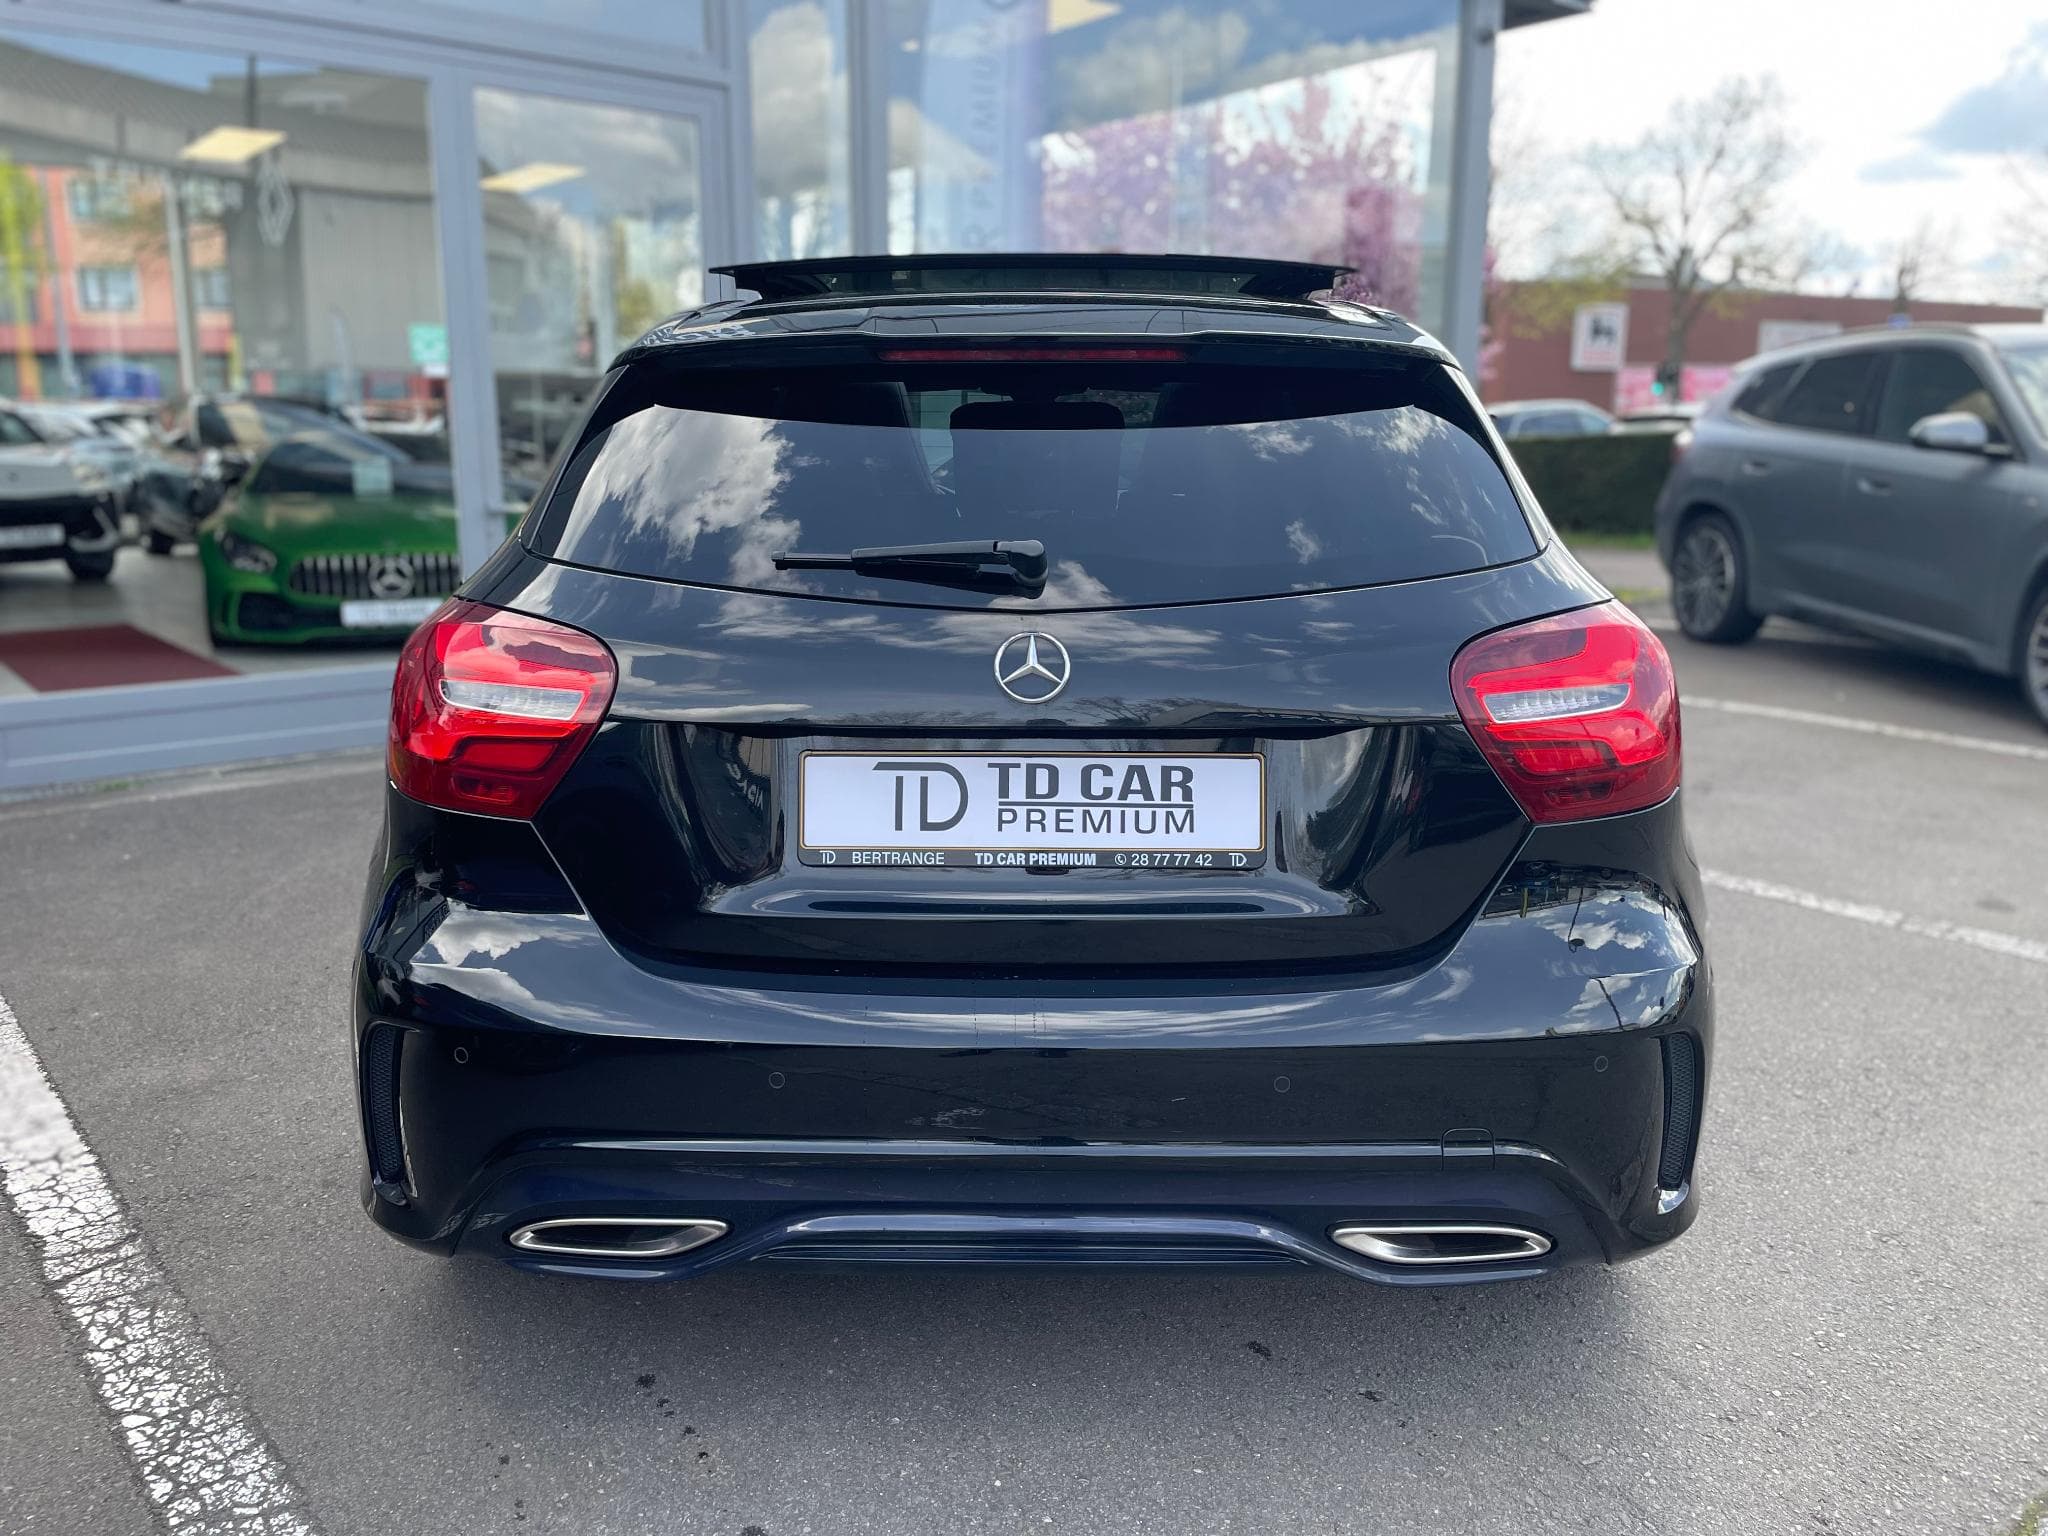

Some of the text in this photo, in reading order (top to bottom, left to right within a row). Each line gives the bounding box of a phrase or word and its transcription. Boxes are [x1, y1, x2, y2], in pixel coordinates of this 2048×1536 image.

[987, 762, 1194, 802] TD CAR
[997, 807, 1195, 835] PREMIUM
[851, 851, 945, 865] BERTRANGE
[974, 852, 1097, 866] TD CAR PREMIUM
[1131, 853, 1213, 867] 28 77 77 42
